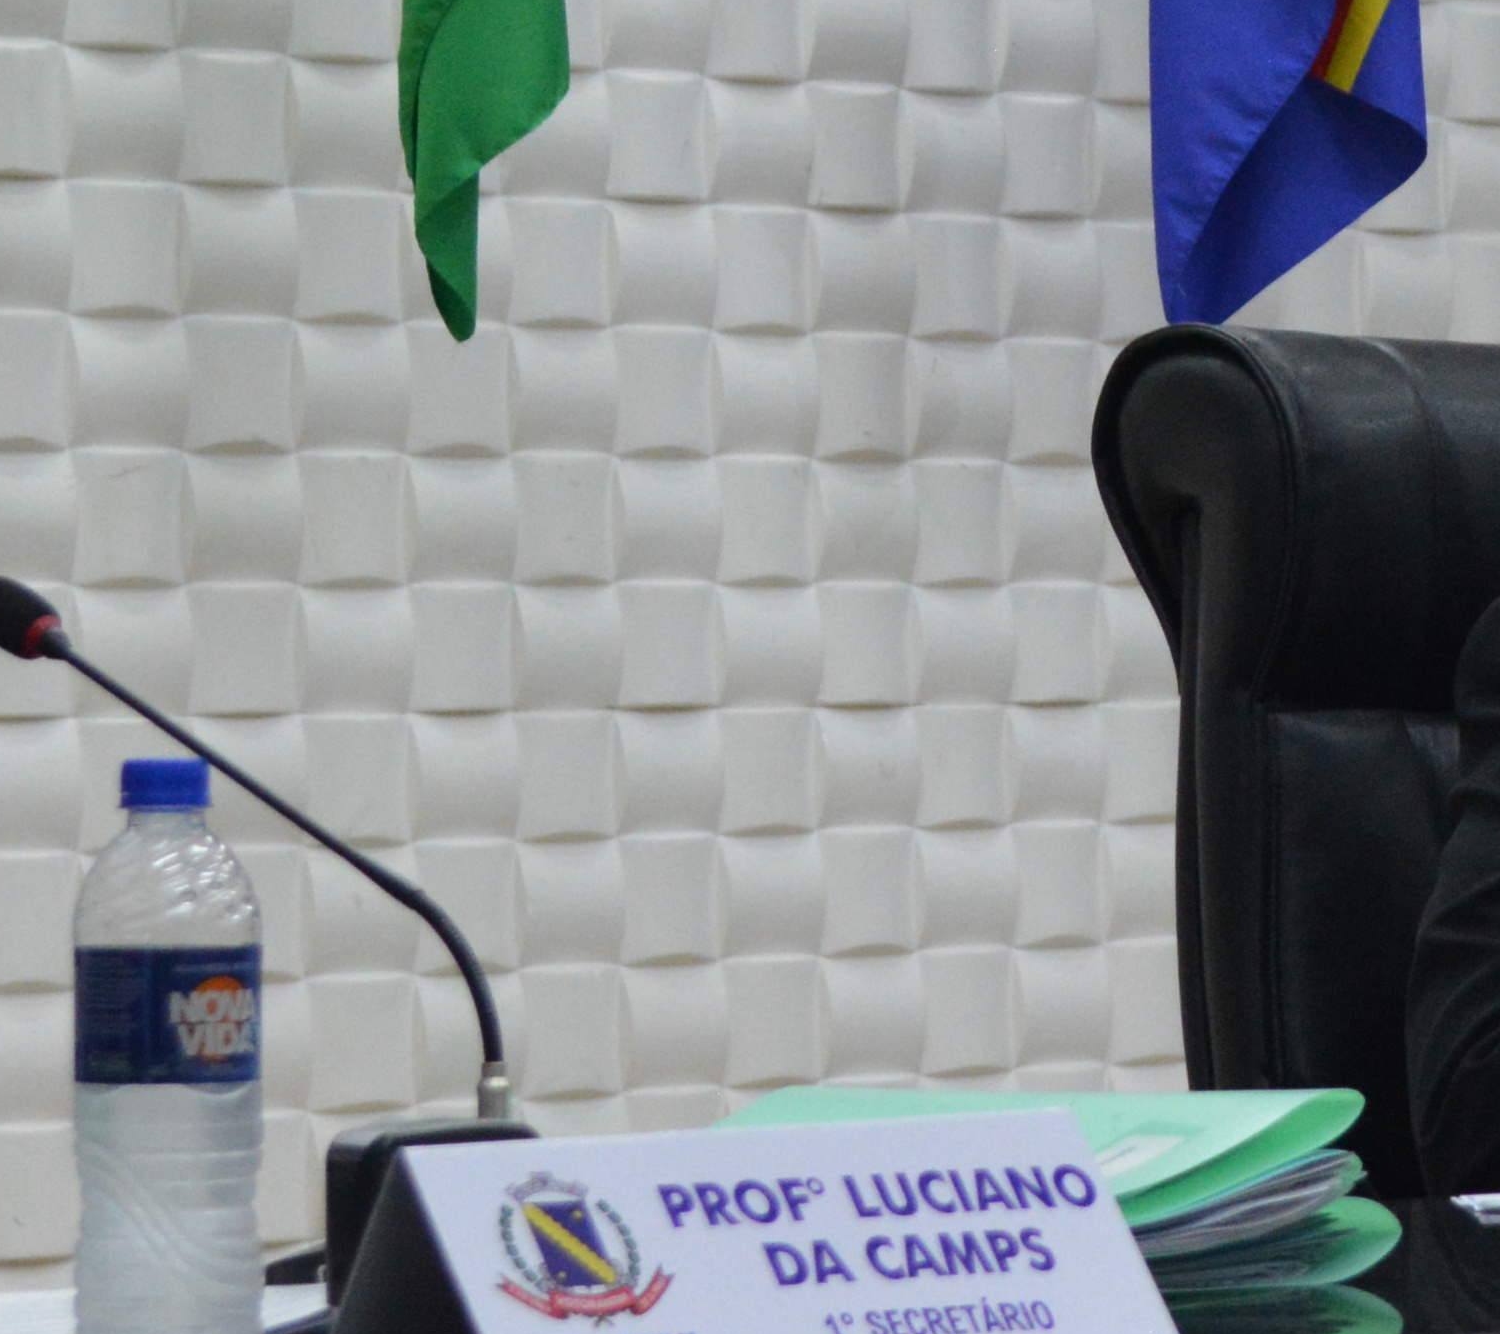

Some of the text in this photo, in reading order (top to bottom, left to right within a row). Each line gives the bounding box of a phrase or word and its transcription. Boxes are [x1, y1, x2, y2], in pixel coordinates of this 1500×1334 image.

[169, 987, 255, 1024] NOVA
[842, 1162, 1099, 1219] LUCIANO
[763, 1226, 1056, 1287] DA CAMPS
